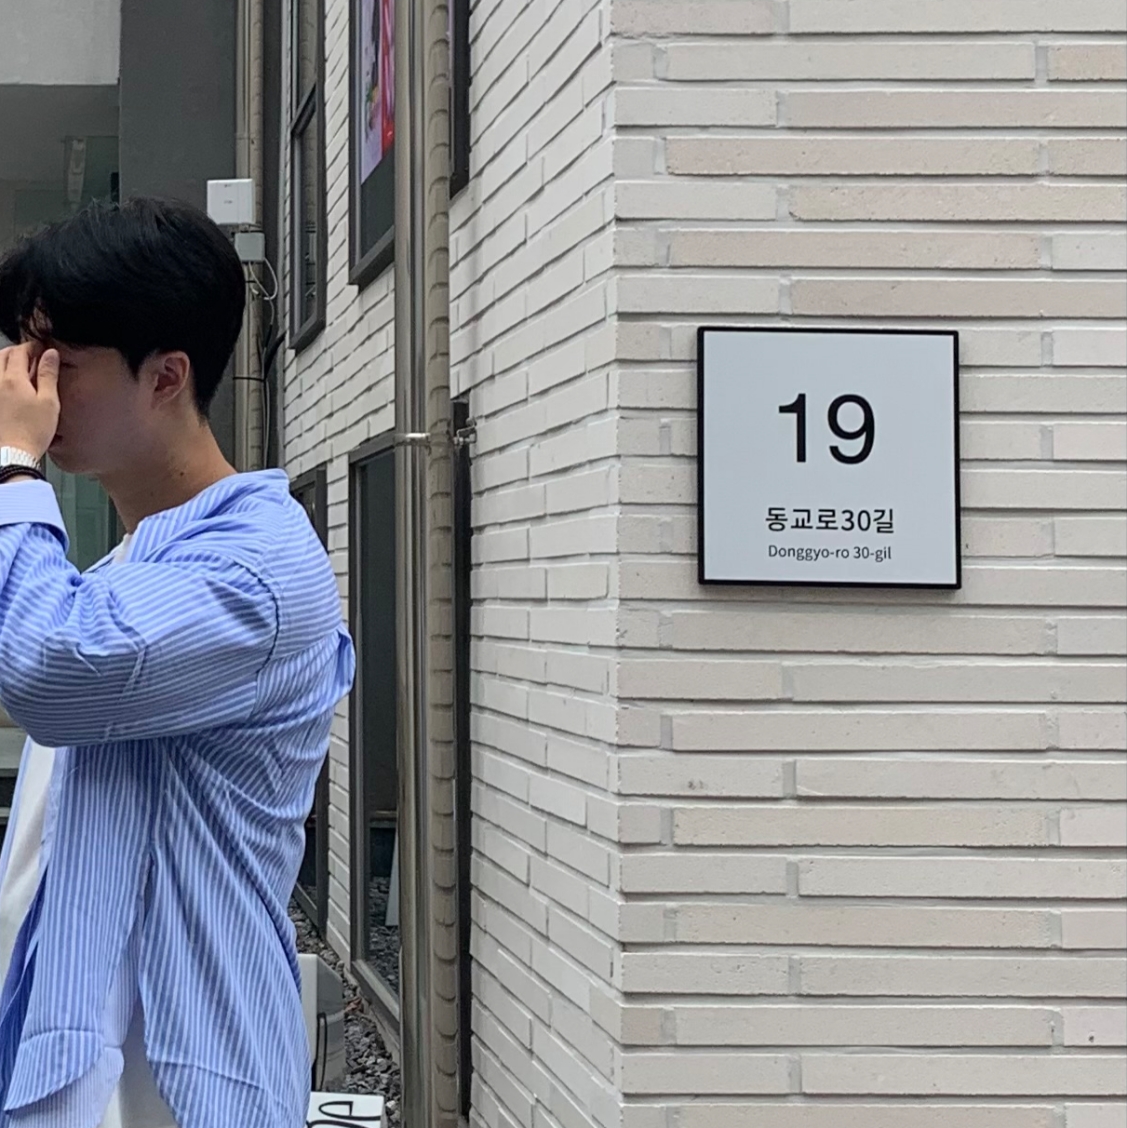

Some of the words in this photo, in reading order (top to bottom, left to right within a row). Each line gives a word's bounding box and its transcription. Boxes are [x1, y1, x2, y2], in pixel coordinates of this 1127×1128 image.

[778, 392, 876, 466] 19
[765, 506, 895, 535] 동교로30길
[768, 544, 850, 562] Donggyo-ro
[853, 546, 892, 563] 30-gil
